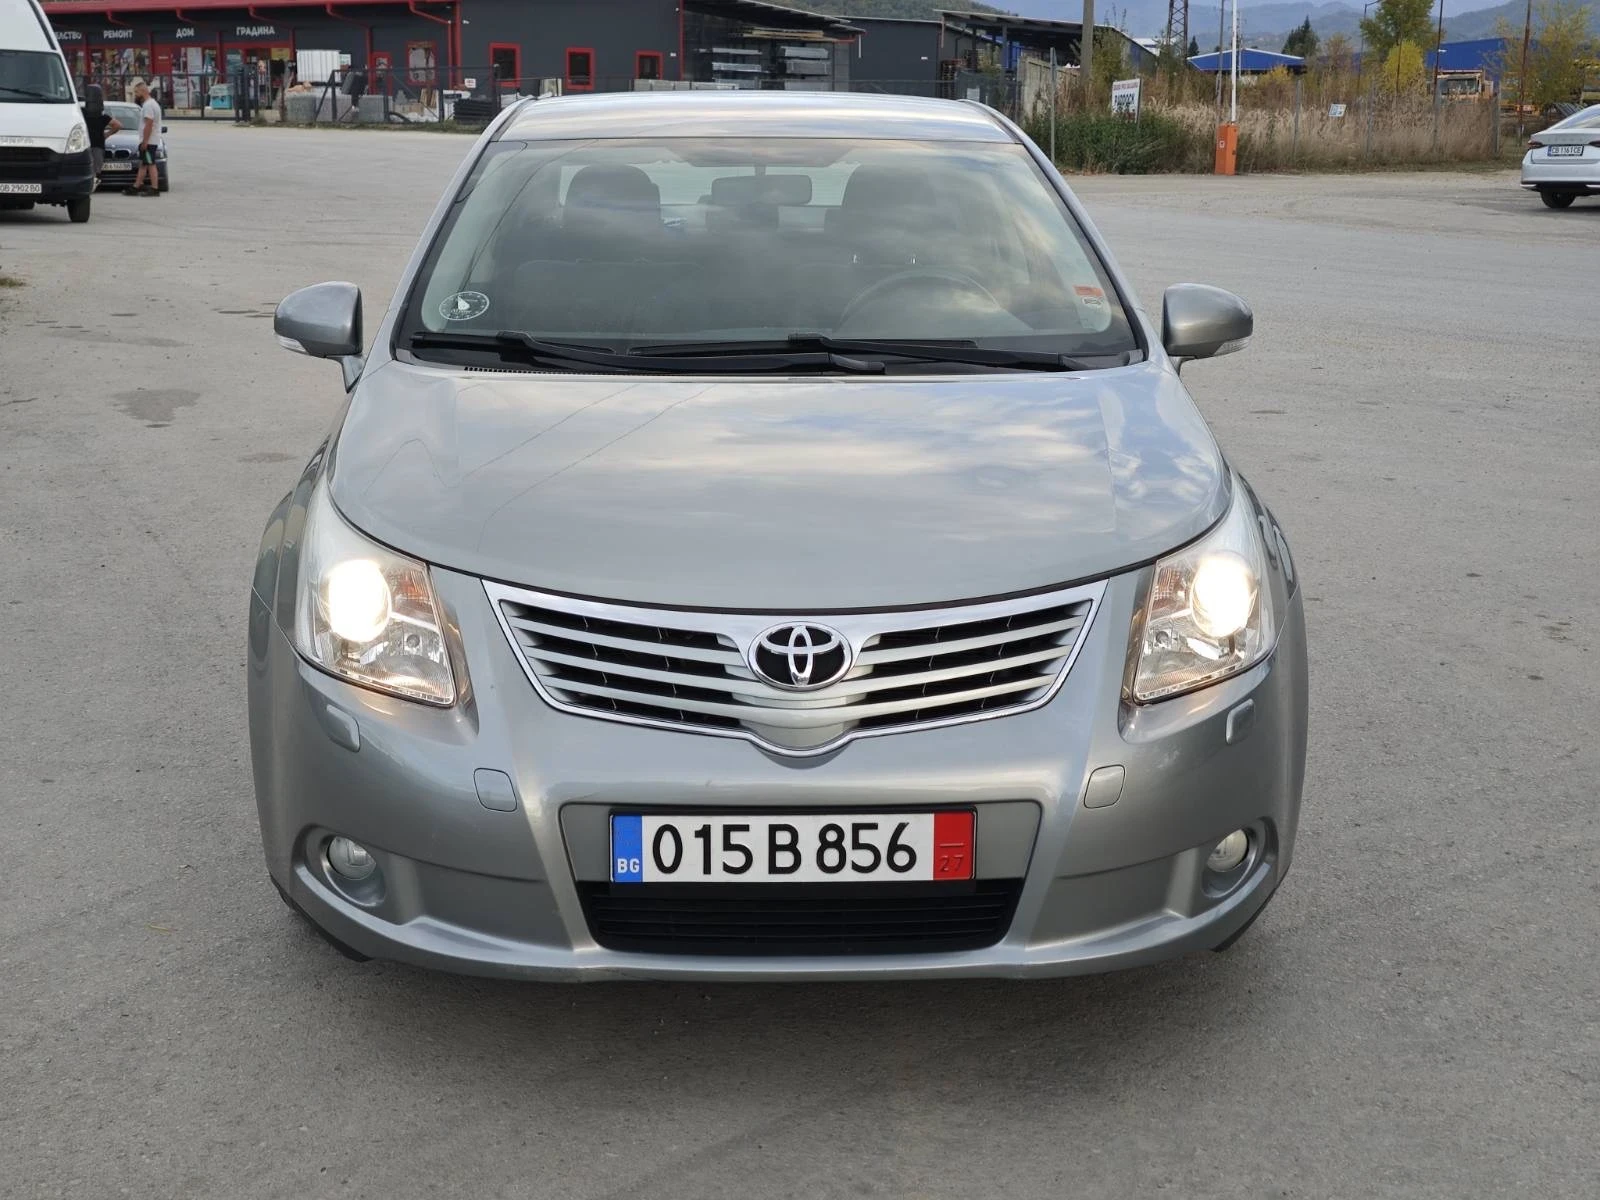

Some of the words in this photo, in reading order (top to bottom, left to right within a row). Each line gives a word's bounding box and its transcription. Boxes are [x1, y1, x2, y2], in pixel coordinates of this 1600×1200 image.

[103, 30, 133, 39] РЕМОНТ
[176, 28, 195, 38] ДОМ
[236, 26, 275, 36] ГРАДИНА
[617, 858, 640, 873] BG
[939, 854, 965, 872] 27
